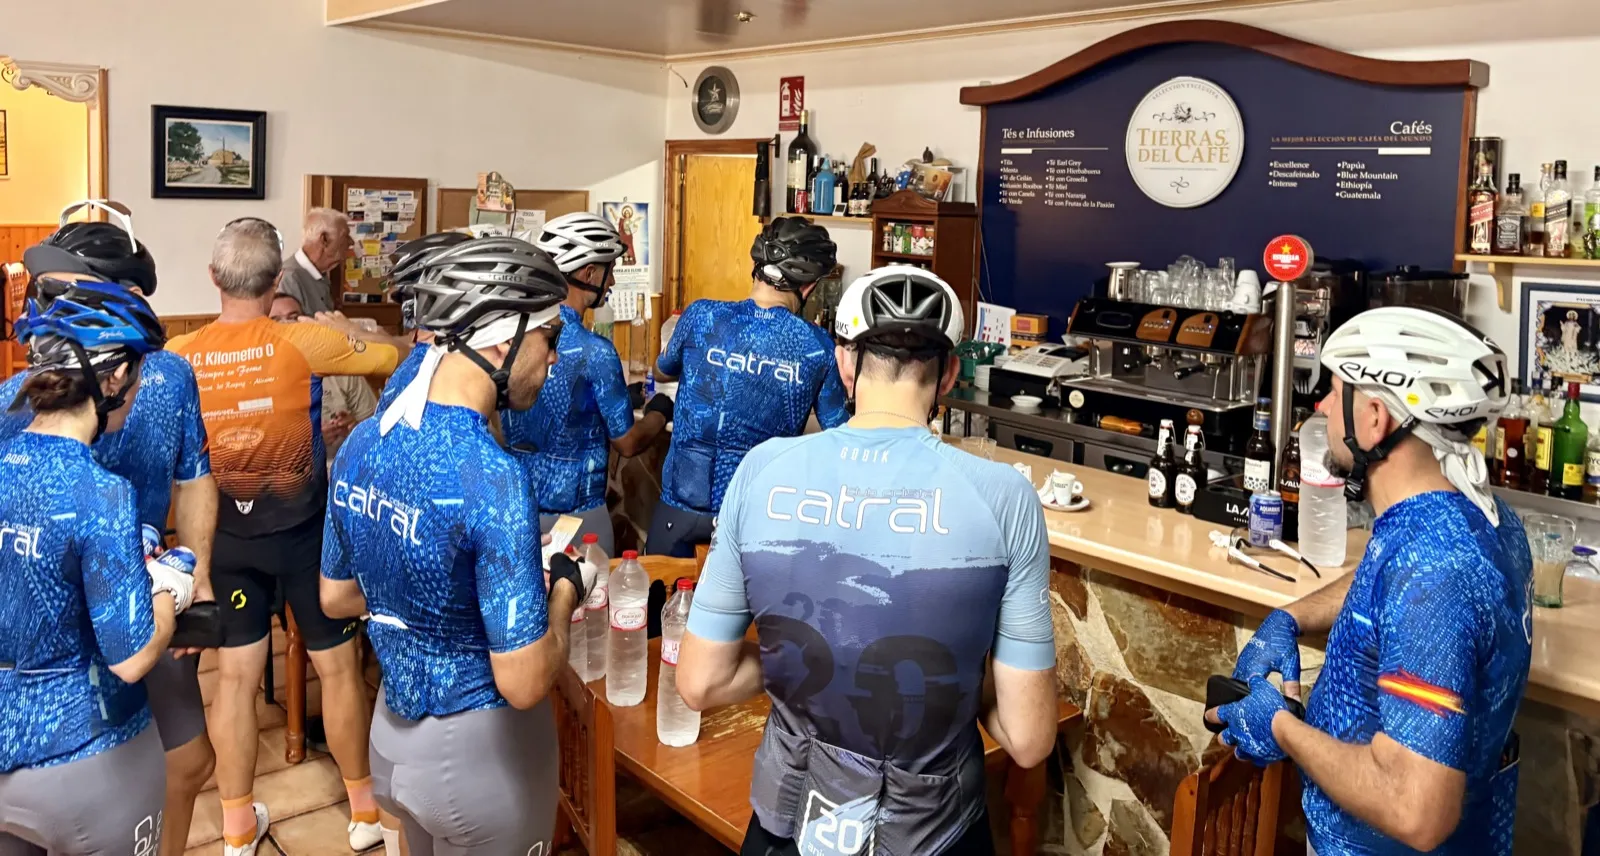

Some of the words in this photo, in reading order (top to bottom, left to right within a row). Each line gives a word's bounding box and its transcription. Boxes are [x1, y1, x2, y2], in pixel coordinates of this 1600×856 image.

[1002, 127, 1017, 139] Tés
[1018, 131, 1024, 139] e
[1026, 127, 1075, 139] Infusiones
[1390, 120, 1433, 135] Cafés
[1136, 127, 1227, 147] TIERRAS
[1138, 148, 1170, 163] DEL
[1175, 141, 1230, 163] CAFÉ
[1068, 160, 1081, 168] Grey
[1273, 160, 1310, 169] Excellence
[1342, 161, 1365, 172] Papúa
[1273, 170, 1320, 179] Descafeinado
[1341, 171, 1358, 179] Blue
[1359, 172, 1398, 180] Mountain
[1272, 179, 1298, 188] Intense
[1340, 181, 1373, 191] Ethiopía
[1065, 192, 1086, 200] Naranja
[1340, 191, 1381, 200] Guatemala
[493, 274, 522, 283] GIRO
[205, 345, 264, 367] Kilometro
[706, 347, 803, 384] catral
[839, 446, 890, 463] GOBIK
[334, 480, 421, 546] catral
[766, 484, 950, 535] catral
[1226, 503, 1240, 515] LA
[815, 806, 864, 855] 20
